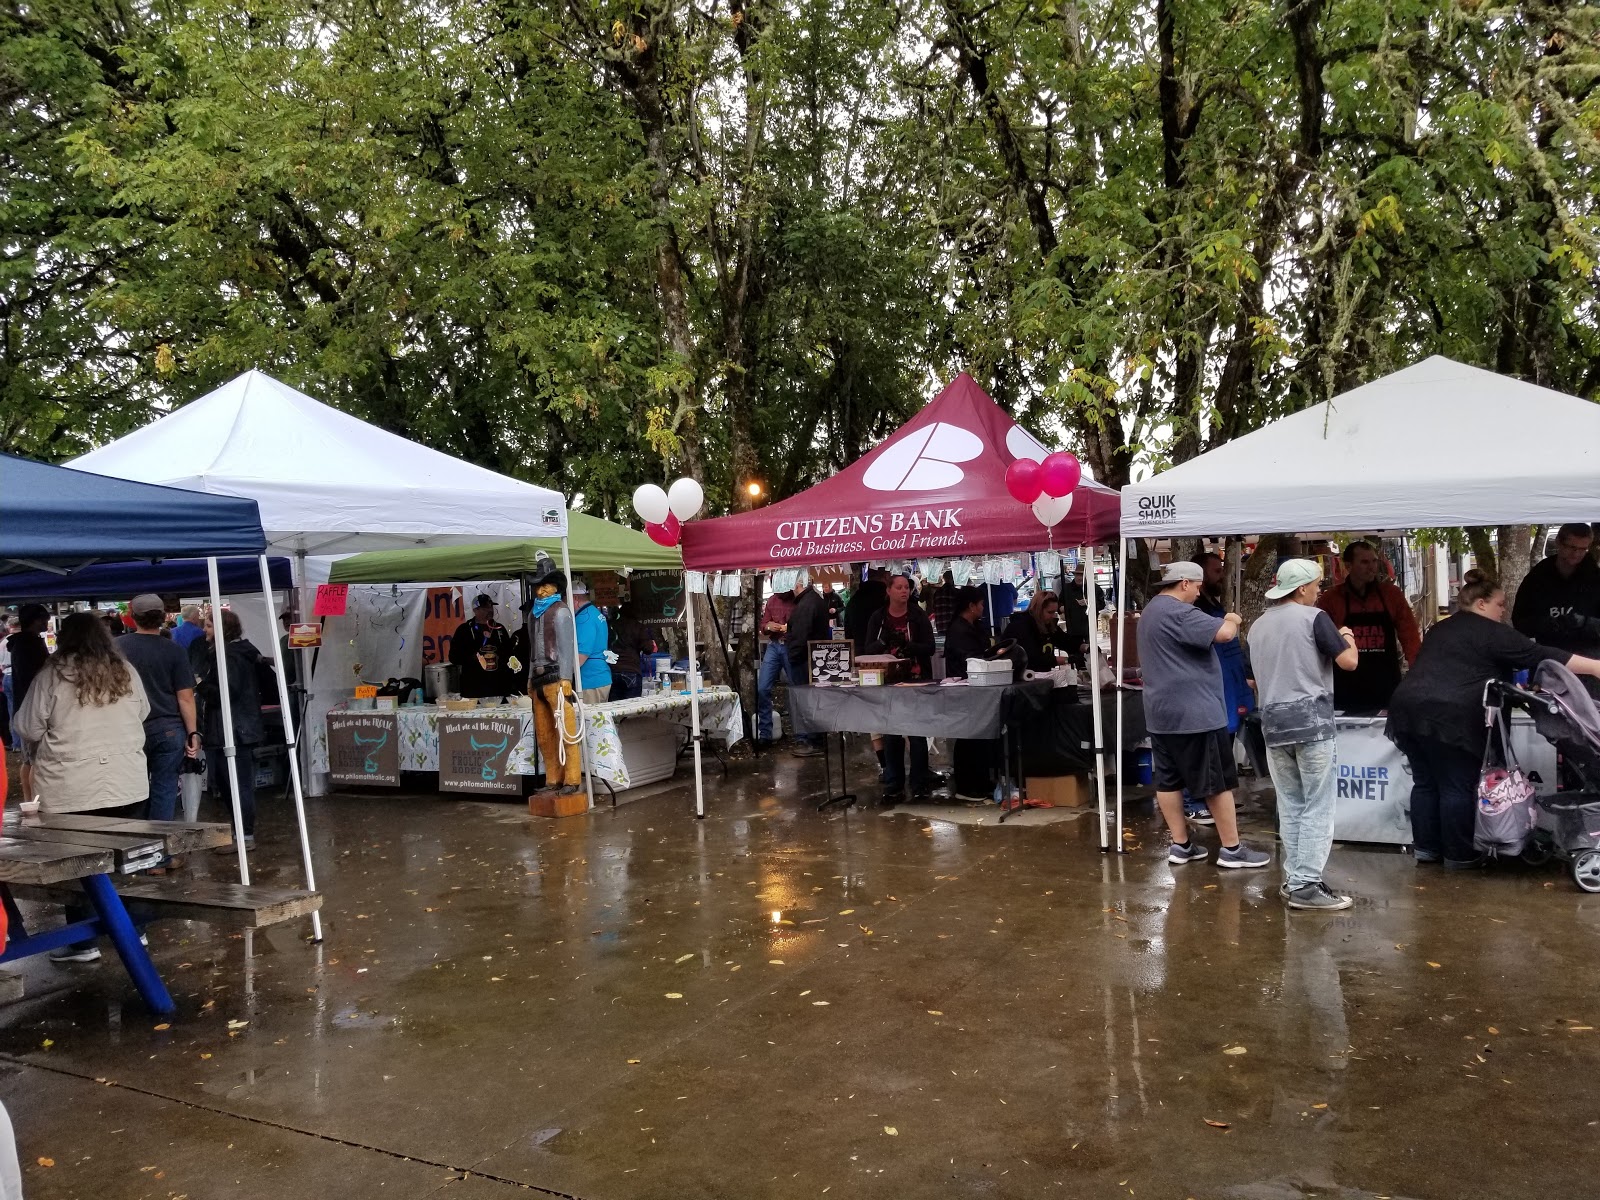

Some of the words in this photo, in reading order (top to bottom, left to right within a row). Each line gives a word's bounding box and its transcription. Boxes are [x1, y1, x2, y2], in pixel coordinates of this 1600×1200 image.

[1138, 494, 1176, 509] QUIK
[1138, 508, 1177, 520] SHADE
[776, 514, 883, 541] CITIZENS
[890, 507, 964, 532] BANK
[770, 541, 802, 558] Good
[805, 539, 866, 556] Business.
[870, 534, 907, 551] Good
[910, 530, 967, 548] Friends.
[317, 584, 346, 599] RAFFLE
[1353, 625, 1385, 636] REAL
[1354, 636, 1385, 648] MEN
[372, 717, 393, 731] FROLIC
[445, 723, 460, 734] Meet
[462, 723, 471, 731] me
[471, 722, 479, 731] at
[480, 722, 490, 731] the
[491, 721, 514, 736] FROLIC
[452, 756, 482, 766] FROLIC
[452, 766, 483, 775] RODEO
[332, 773, 396, 783] www.philomathfrolic.org
[444, 780, 517, 791] www.philomathfrolic.org
